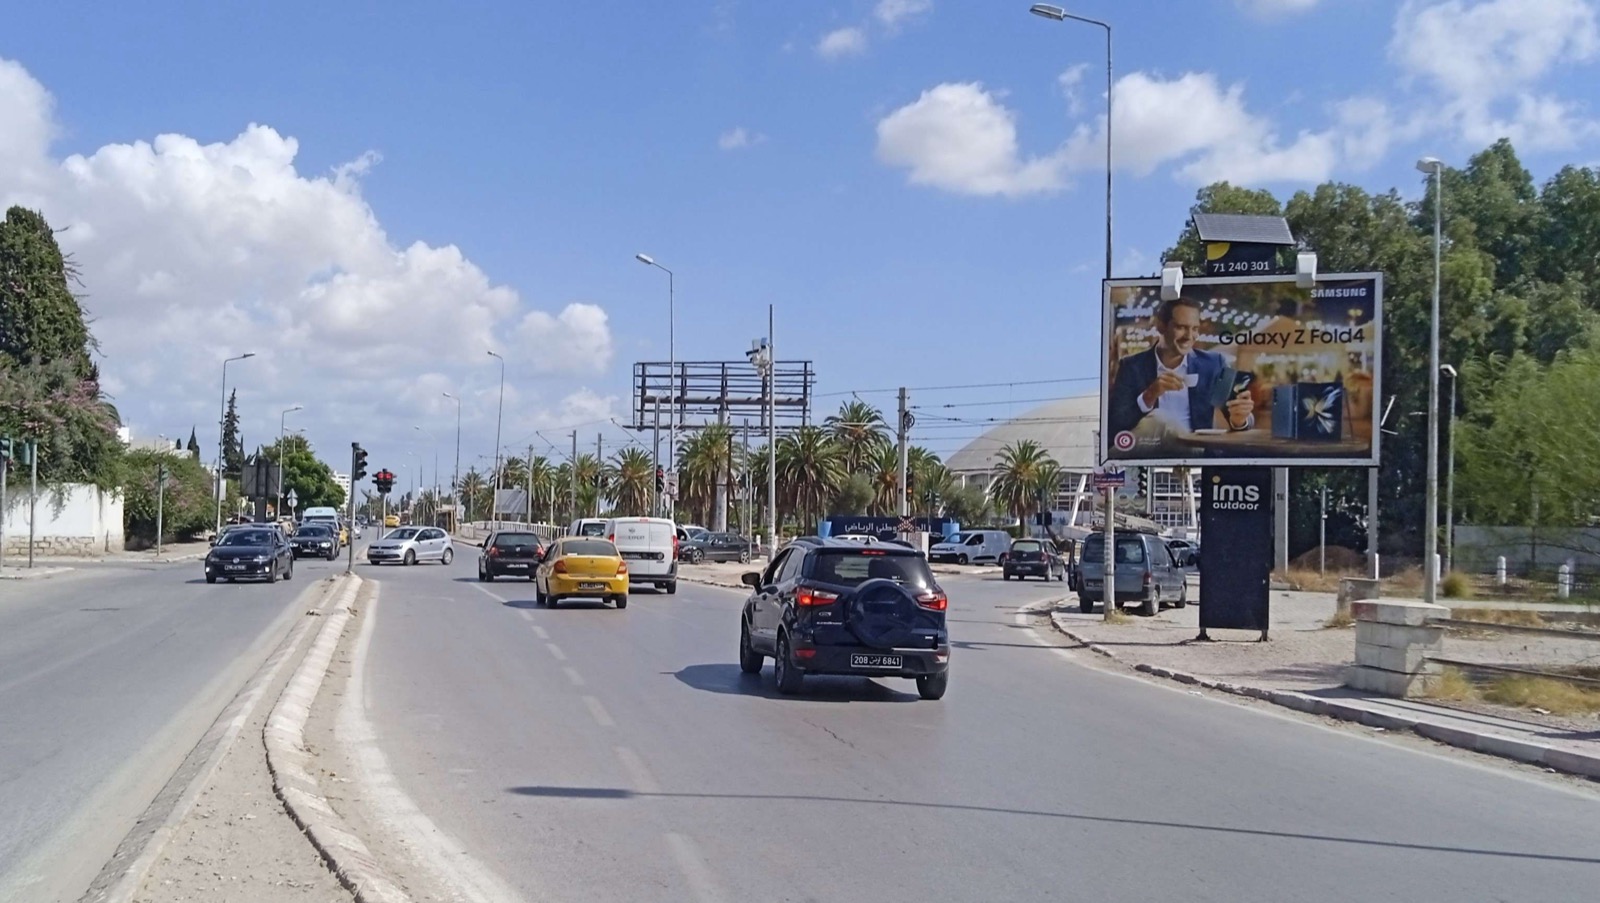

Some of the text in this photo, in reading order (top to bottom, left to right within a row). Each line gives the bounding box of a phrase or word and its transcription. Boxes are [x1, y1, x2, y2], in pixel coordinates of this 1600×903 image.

[1213, 261, 1270, 272] 71 240 301
[1310, 288, 1366, 298] SAMSUNG
[1219, 328, 1365, 348] Galaxy Z Fold4
[1212, 475, 1260, 502] ims
[1212, 501, 1259, 510] outdoor
[854, 656, 868, 664] 208
[883, 657, 899, 665] 6841
